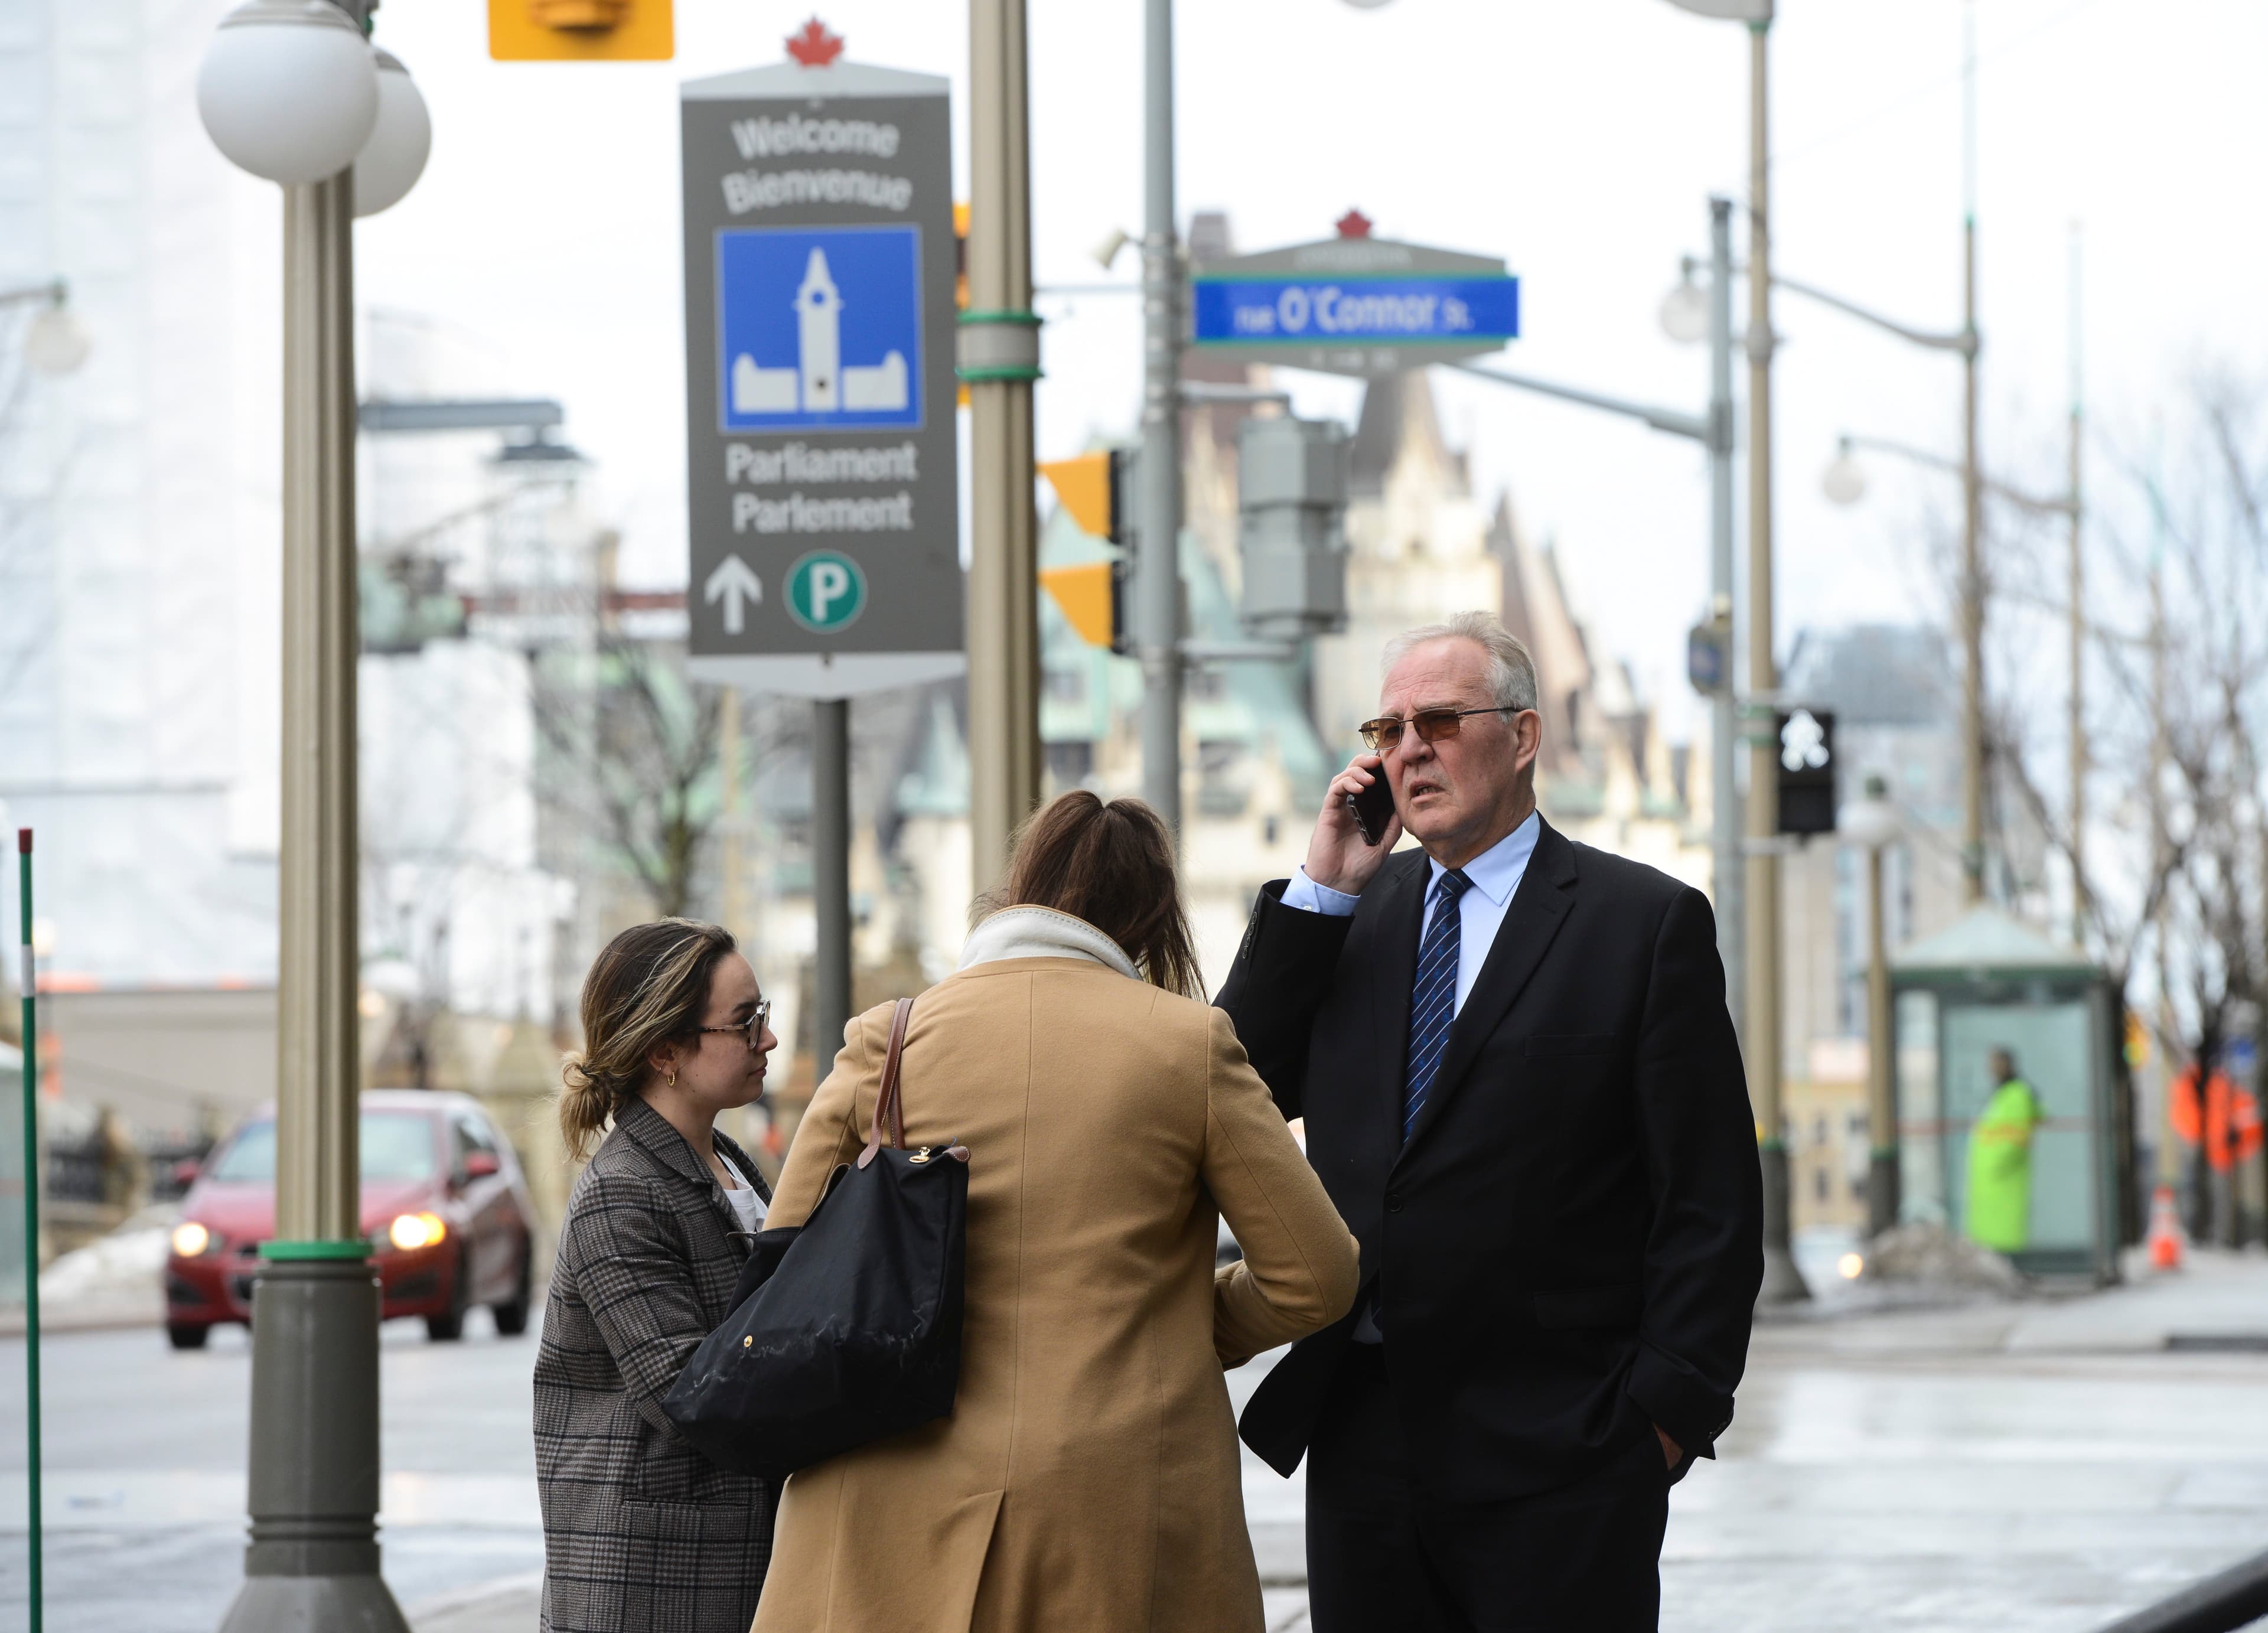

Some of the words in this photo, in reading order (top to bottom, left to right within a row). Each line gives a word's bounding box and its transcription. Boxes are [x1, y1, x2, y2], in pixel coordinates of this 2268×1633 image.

[732, 112, 900, 159] Welcome
[721, 170, 912, 214] Bienvenue
[1278, 286, 1438, 332] O'Connor
[726, 441, 918, 484] Parliament
[732, 491, 914, 532] Parlement
[810, 562, 850, 622] P
